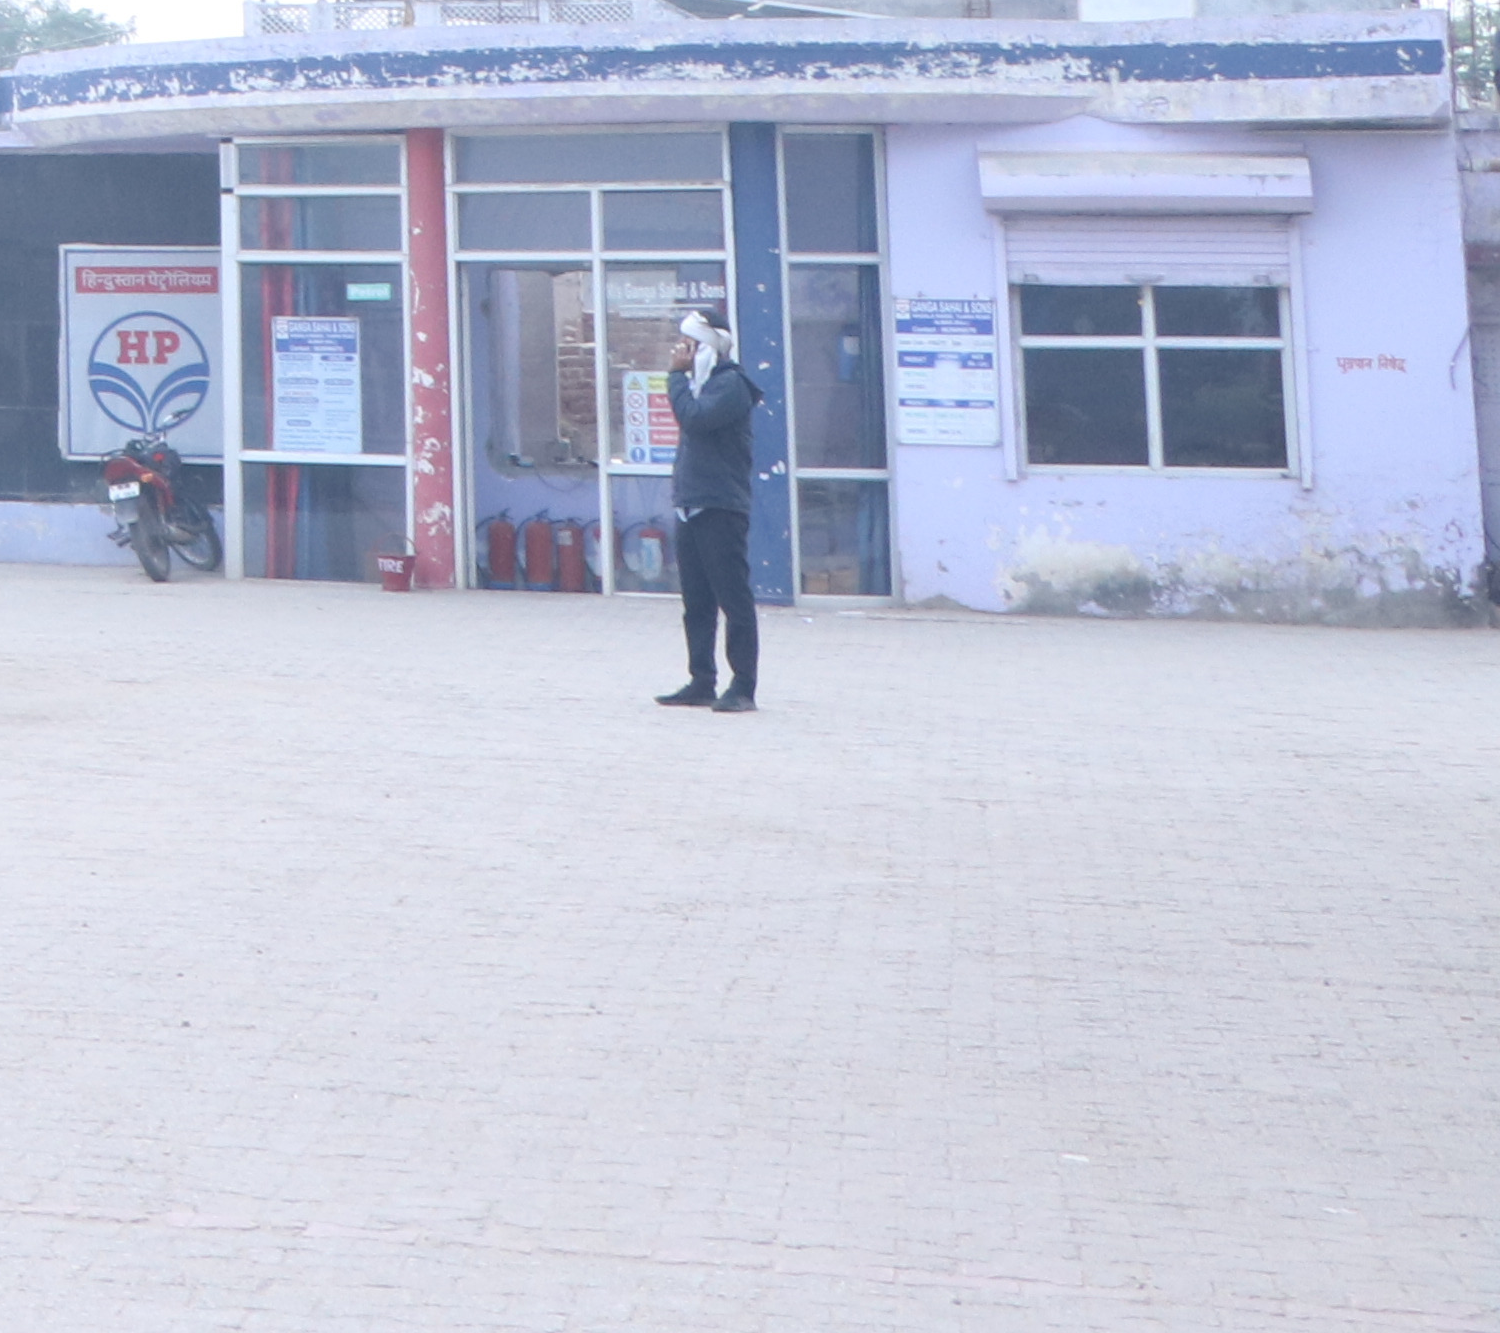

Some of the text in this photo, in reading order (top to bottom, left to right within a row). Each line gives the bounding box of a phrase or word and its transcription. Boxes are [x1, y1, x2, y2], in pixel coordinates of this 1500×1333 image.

[81, 269, 212, 292] हिन्दुस्तान पेट्रोलियम
[689, 281, 698, 299] &
[699, 281, 725, 299] Sons
[116, 330, 181, 365] HP
